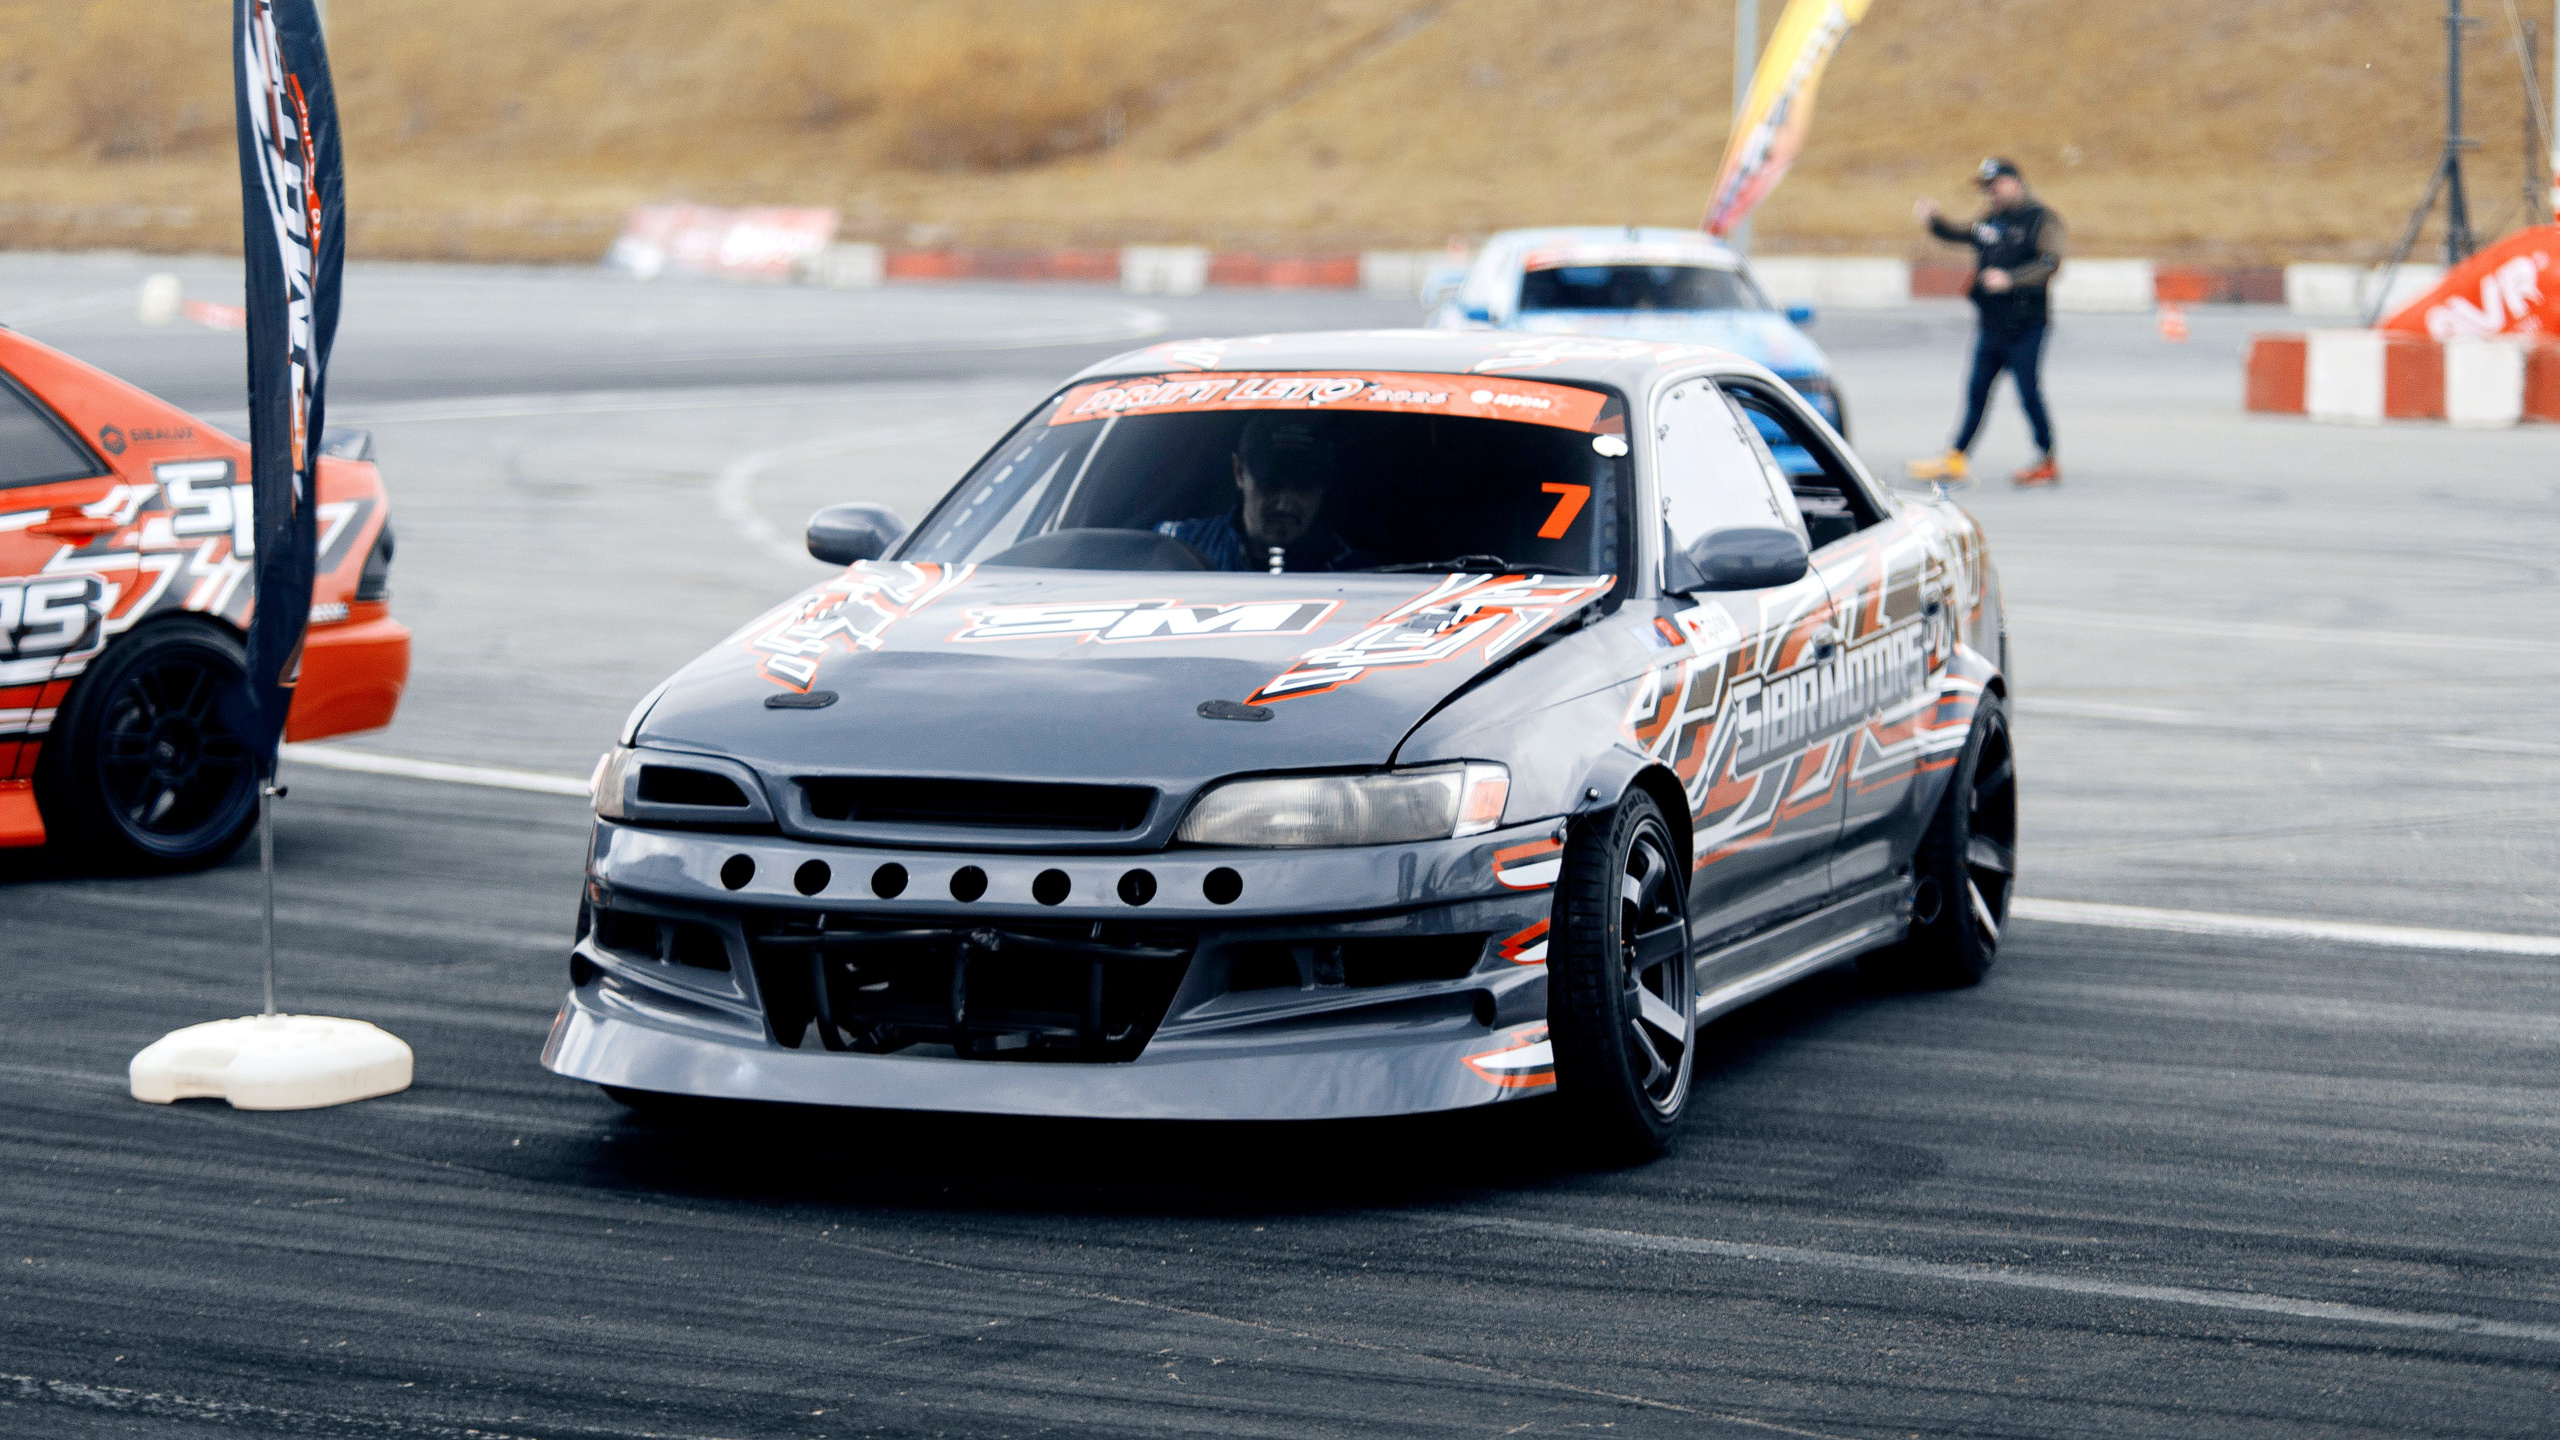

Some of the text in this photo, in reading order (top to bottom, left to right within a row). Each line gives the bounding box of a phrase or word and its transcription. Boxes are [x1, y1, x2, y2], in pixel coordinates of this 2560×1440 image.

[1074, 378, 1238, 416] DRIFT
[1225, 378, 1365, 402] LETO
[1537, 482, 1591, 539] 7
